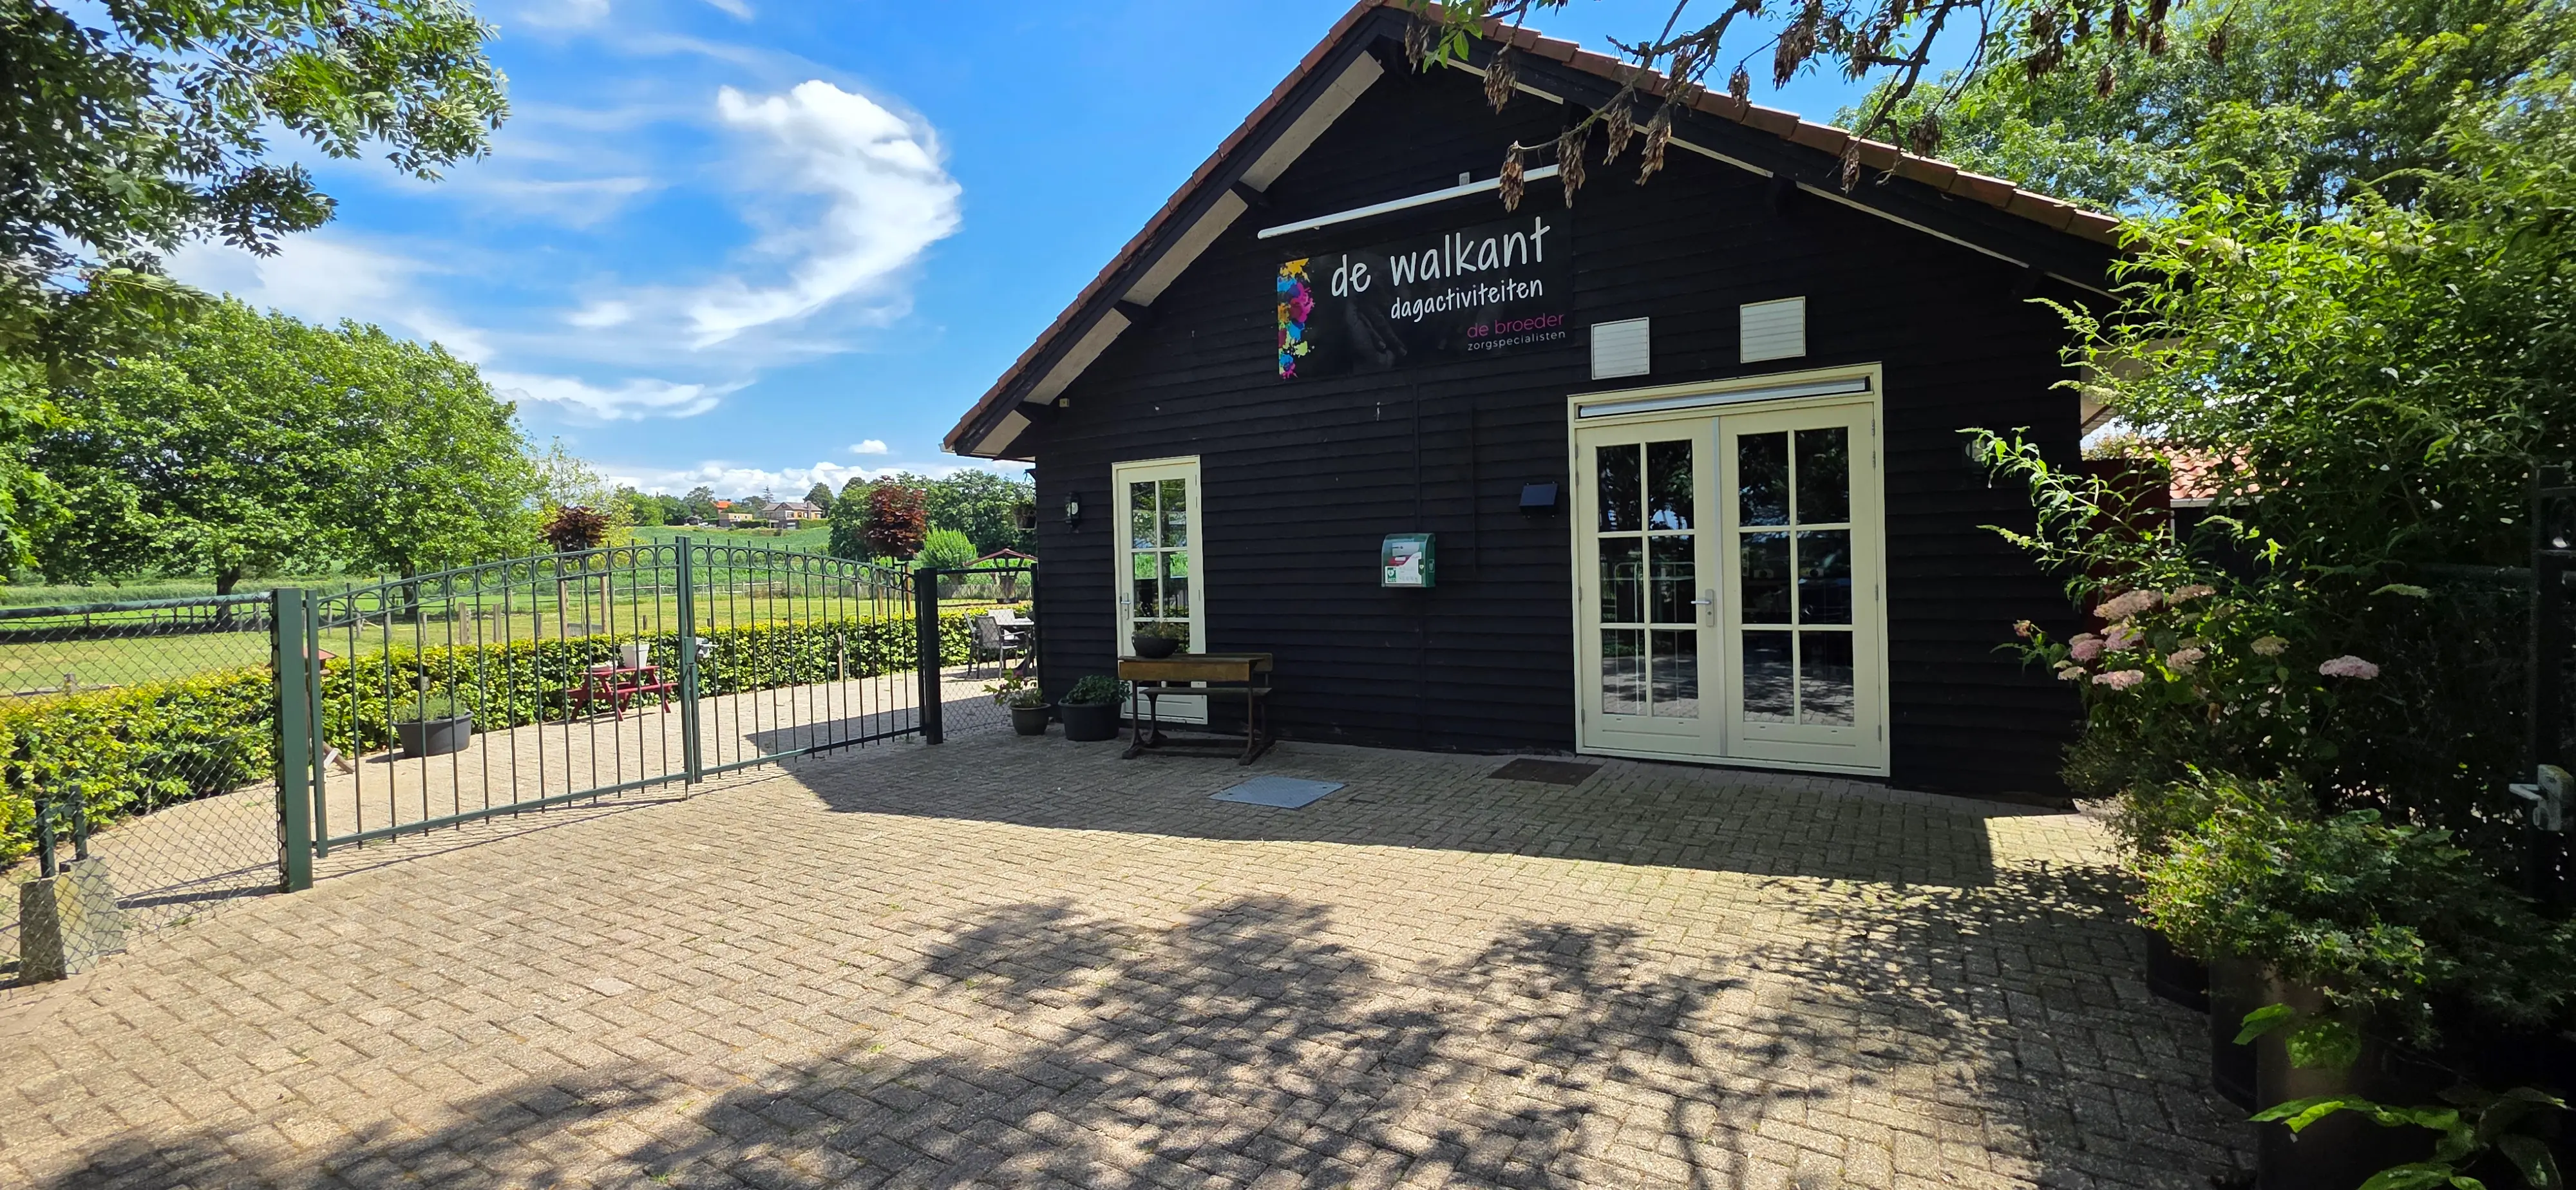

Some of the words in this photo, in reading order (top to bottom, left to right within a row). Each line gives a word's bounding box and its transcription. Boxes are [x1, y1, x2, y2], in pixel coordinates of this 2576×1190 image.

[1331, 254, 1371, 297] de
[1390, 216, 1550, 286] walkant
[1391, 278, 1543, 322] dagactiviteiten
[1467, 323, 1489, 338] de
[1495, 313, 1564, 334] broeder
[1468, 331, 1566, 350] zorgspecialisten
